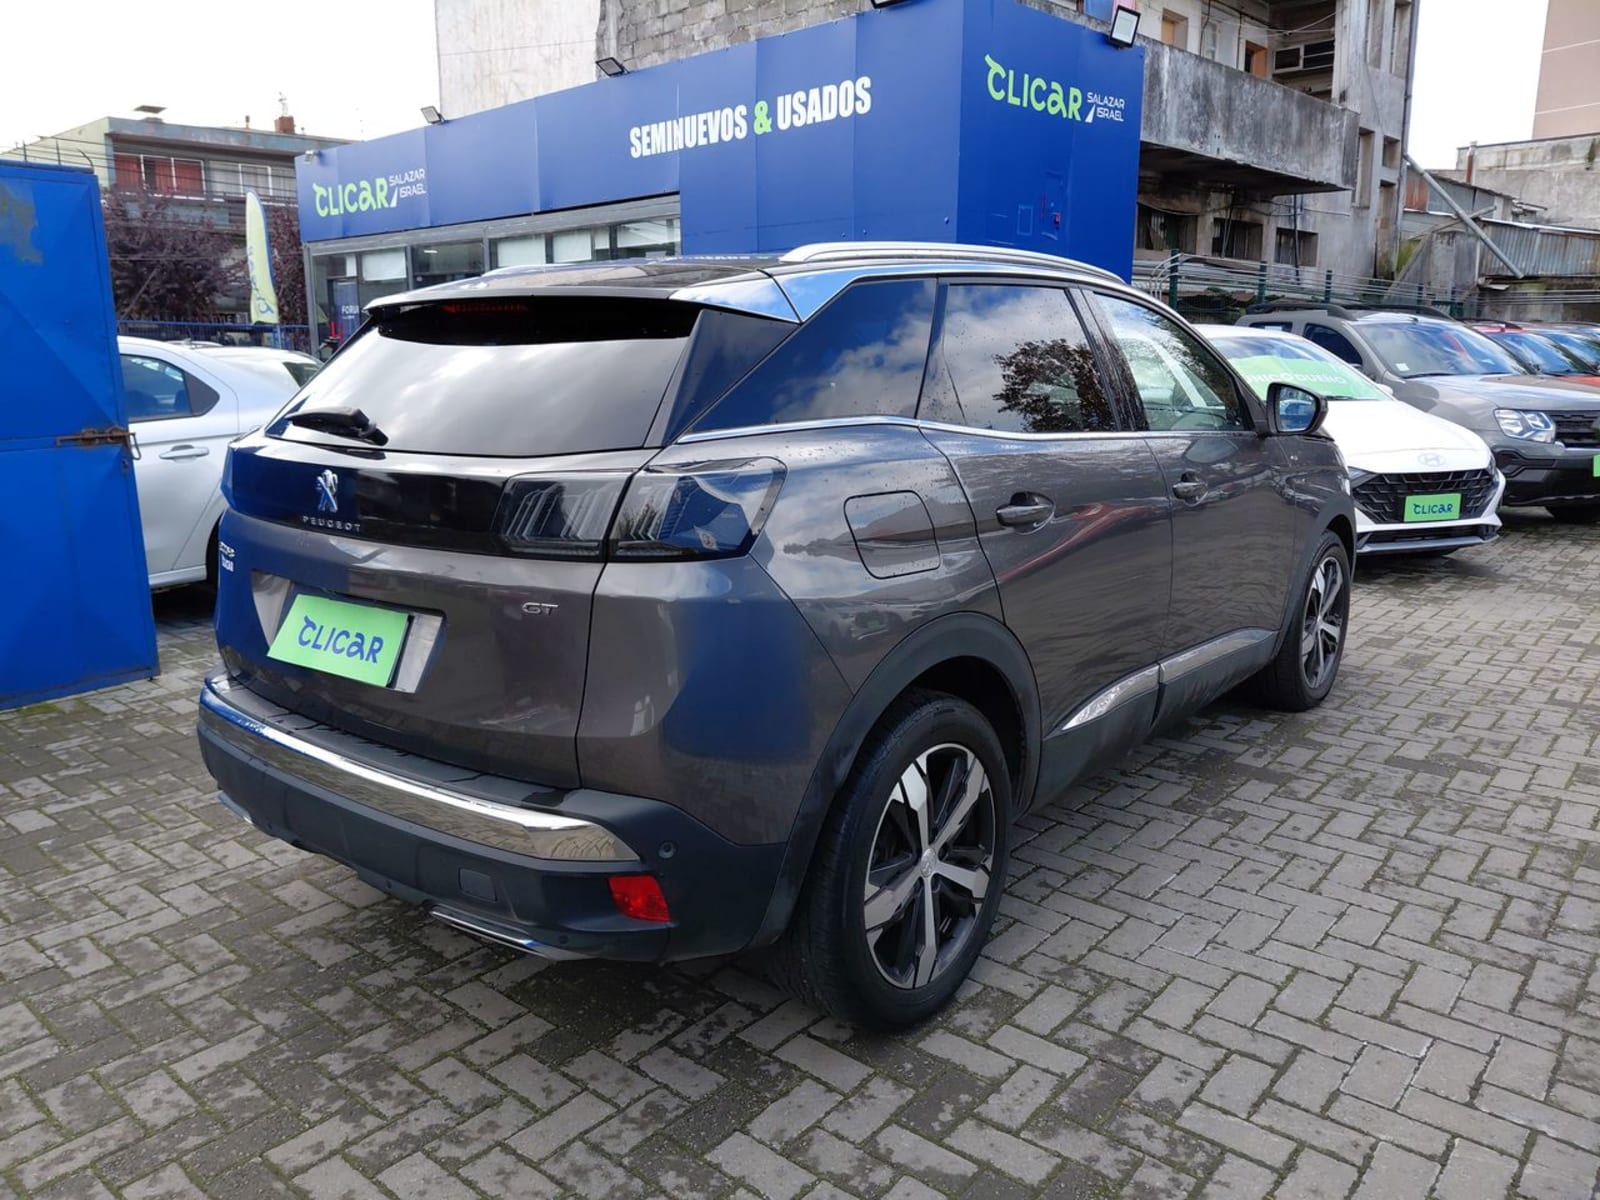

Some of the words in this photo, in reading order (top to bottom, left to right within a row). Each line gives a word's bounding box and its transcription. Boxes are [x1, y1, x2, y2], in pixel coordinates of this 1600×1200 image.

[1086, 91, 1126, 110] SALAZAR
[629, 104, 748, 159] SEMINUEVOS
[754, 100, 772, 135] &
[776, 76, 872, 131] USADOS
[1096, 107, 1125, 123] ISRAEL
[389, 168, 426, 187] SALAZAR
[302, 514, 361, 533] PEUGEOT
[521, 601, 559, 615] GT
